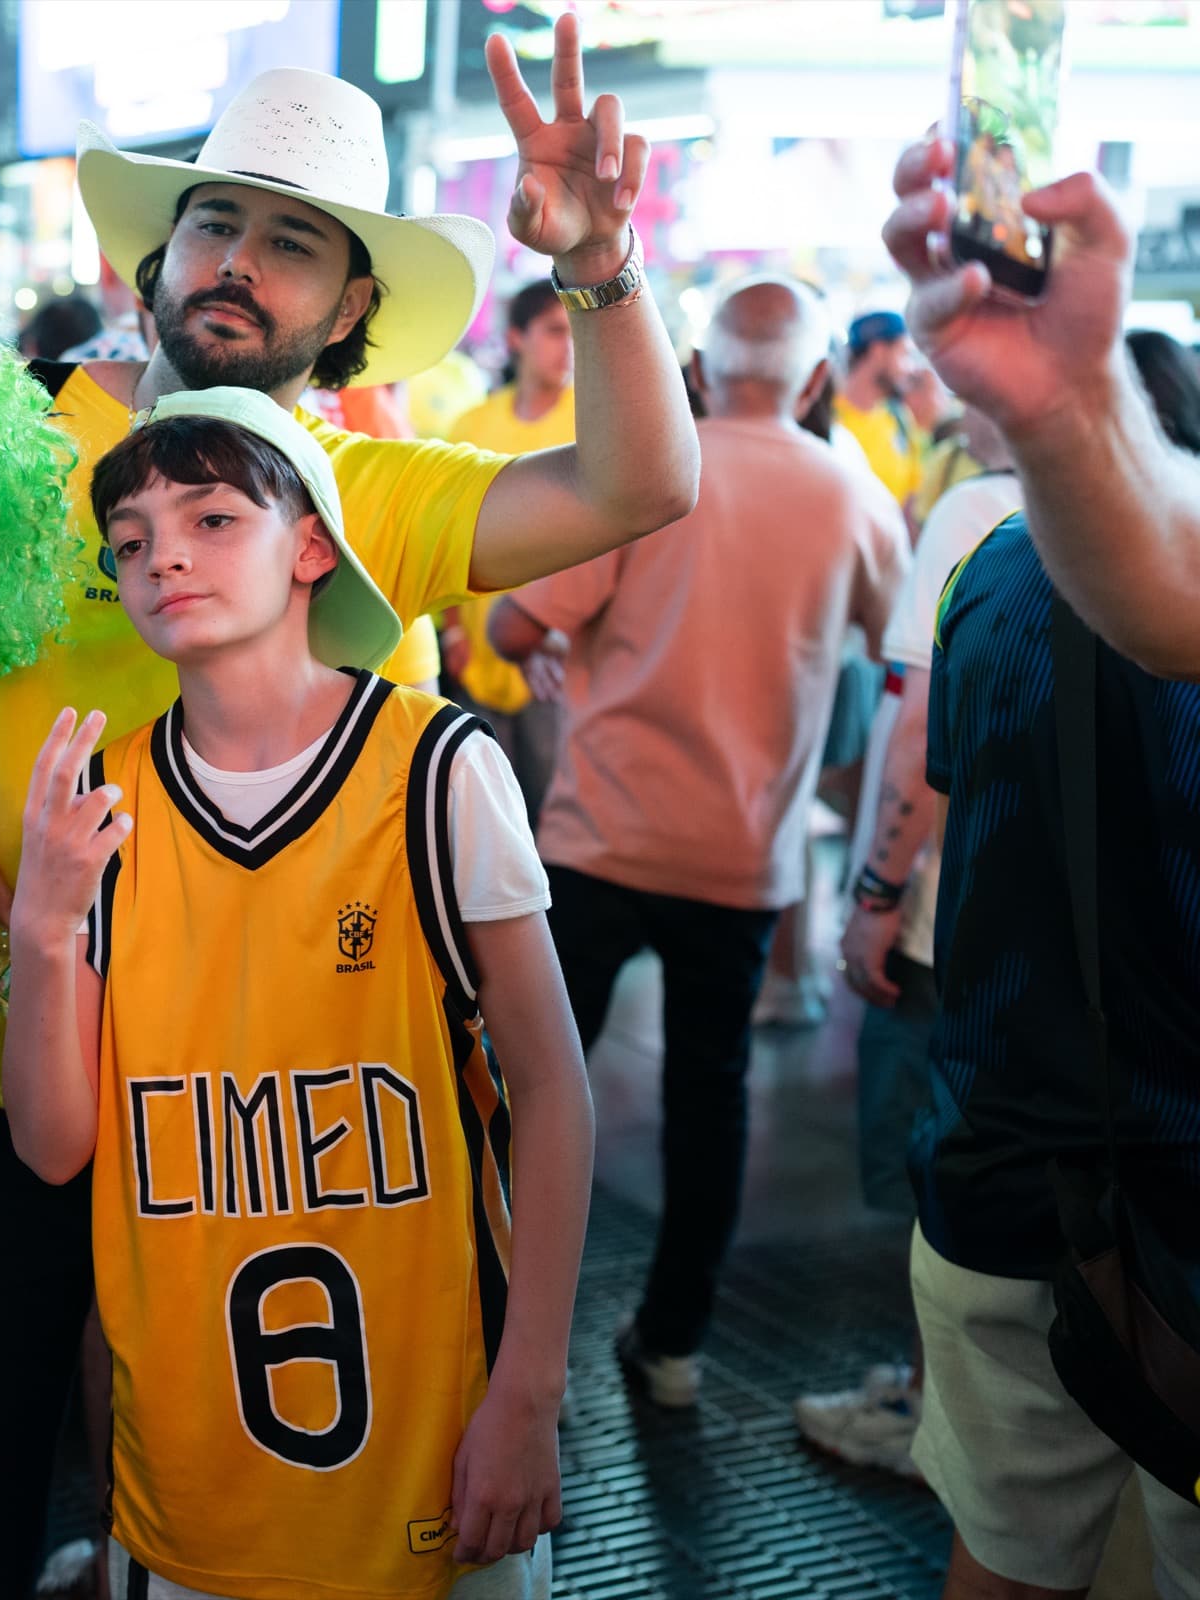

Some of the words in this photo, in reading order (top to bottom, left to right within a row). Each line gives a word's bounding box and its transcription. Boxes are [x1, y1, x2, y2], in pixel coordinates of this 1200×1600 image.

[336, 960, 376, 974] BRASIL
[127, 1062, 432, 1218] CIMED
[225, 1242, 373, 1472] 8
